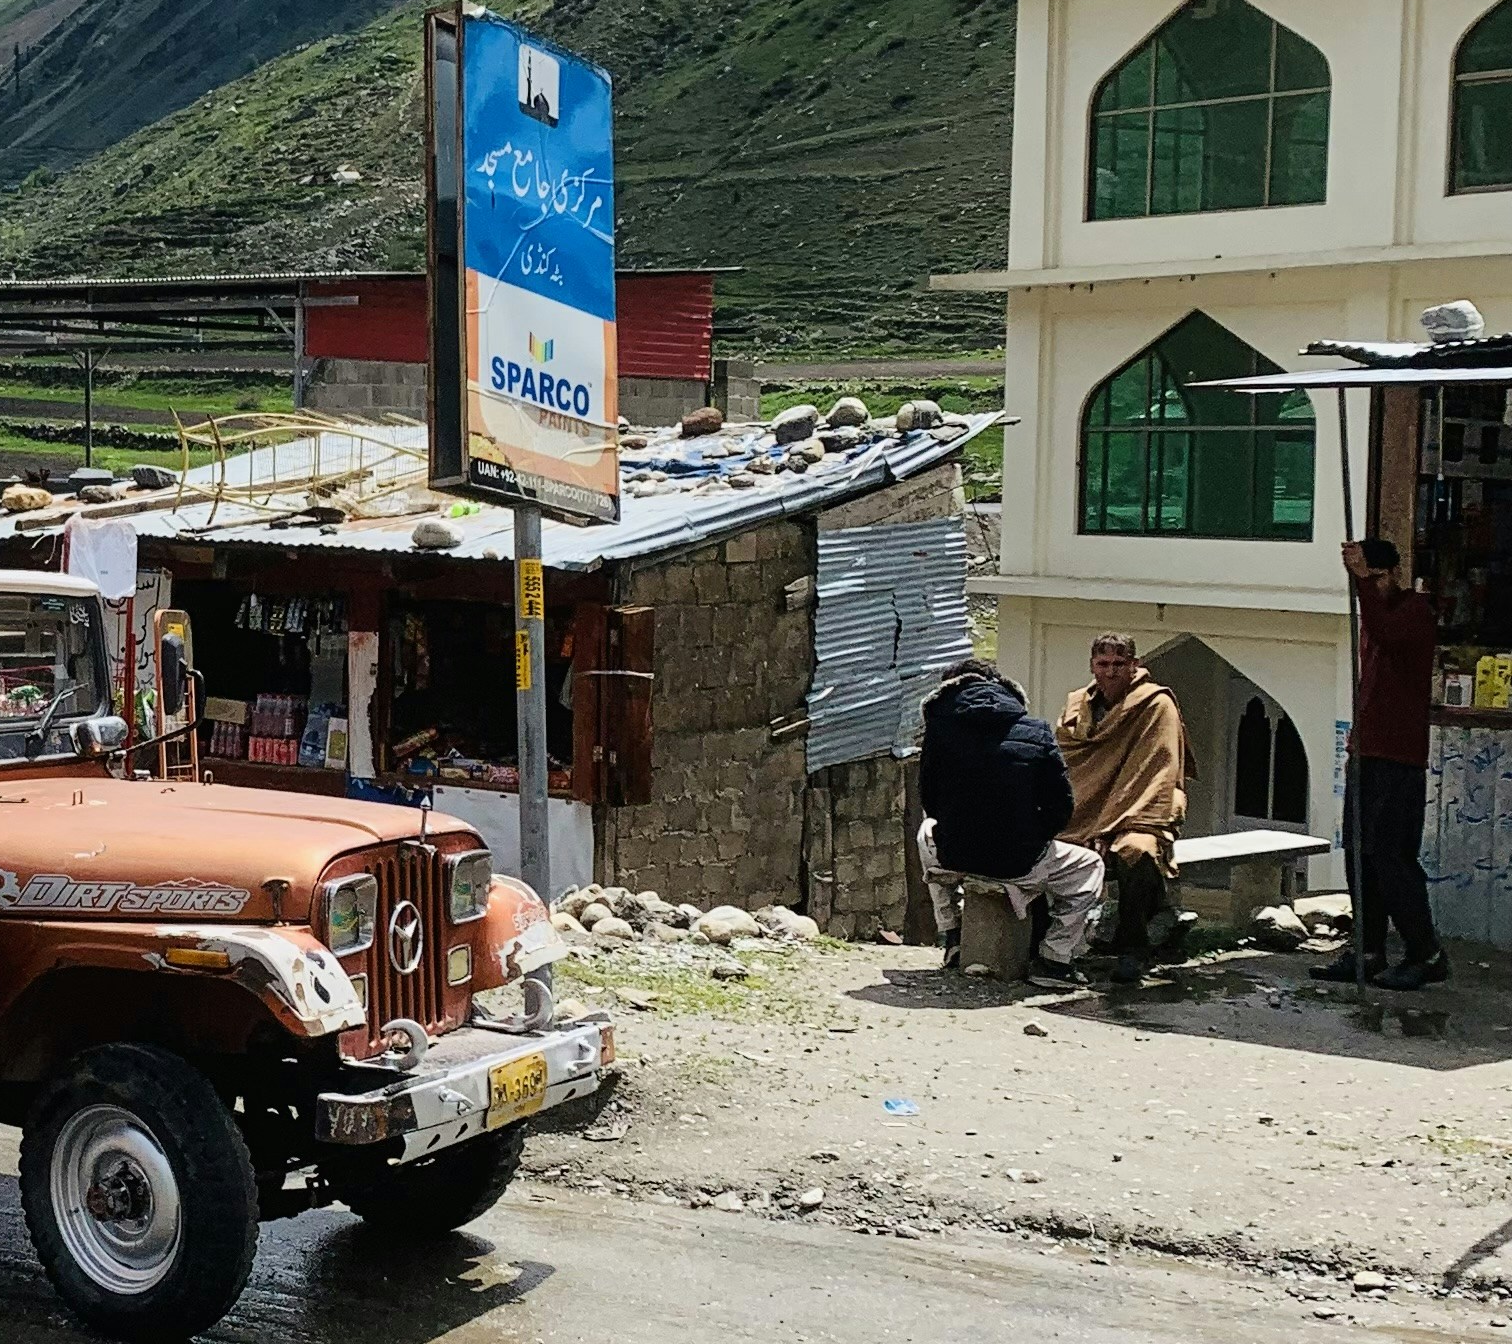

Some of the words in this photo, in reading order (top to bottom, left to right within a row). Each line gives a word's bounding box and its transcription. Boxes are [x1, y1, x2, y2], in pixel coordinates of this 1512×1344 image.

[491, 355, 591, 417] SPARCO
[477, 460, 500, 481] UAN:
[16, 874, 128, 909] DIRT
[120, 886, 247, 912] SPORTS
